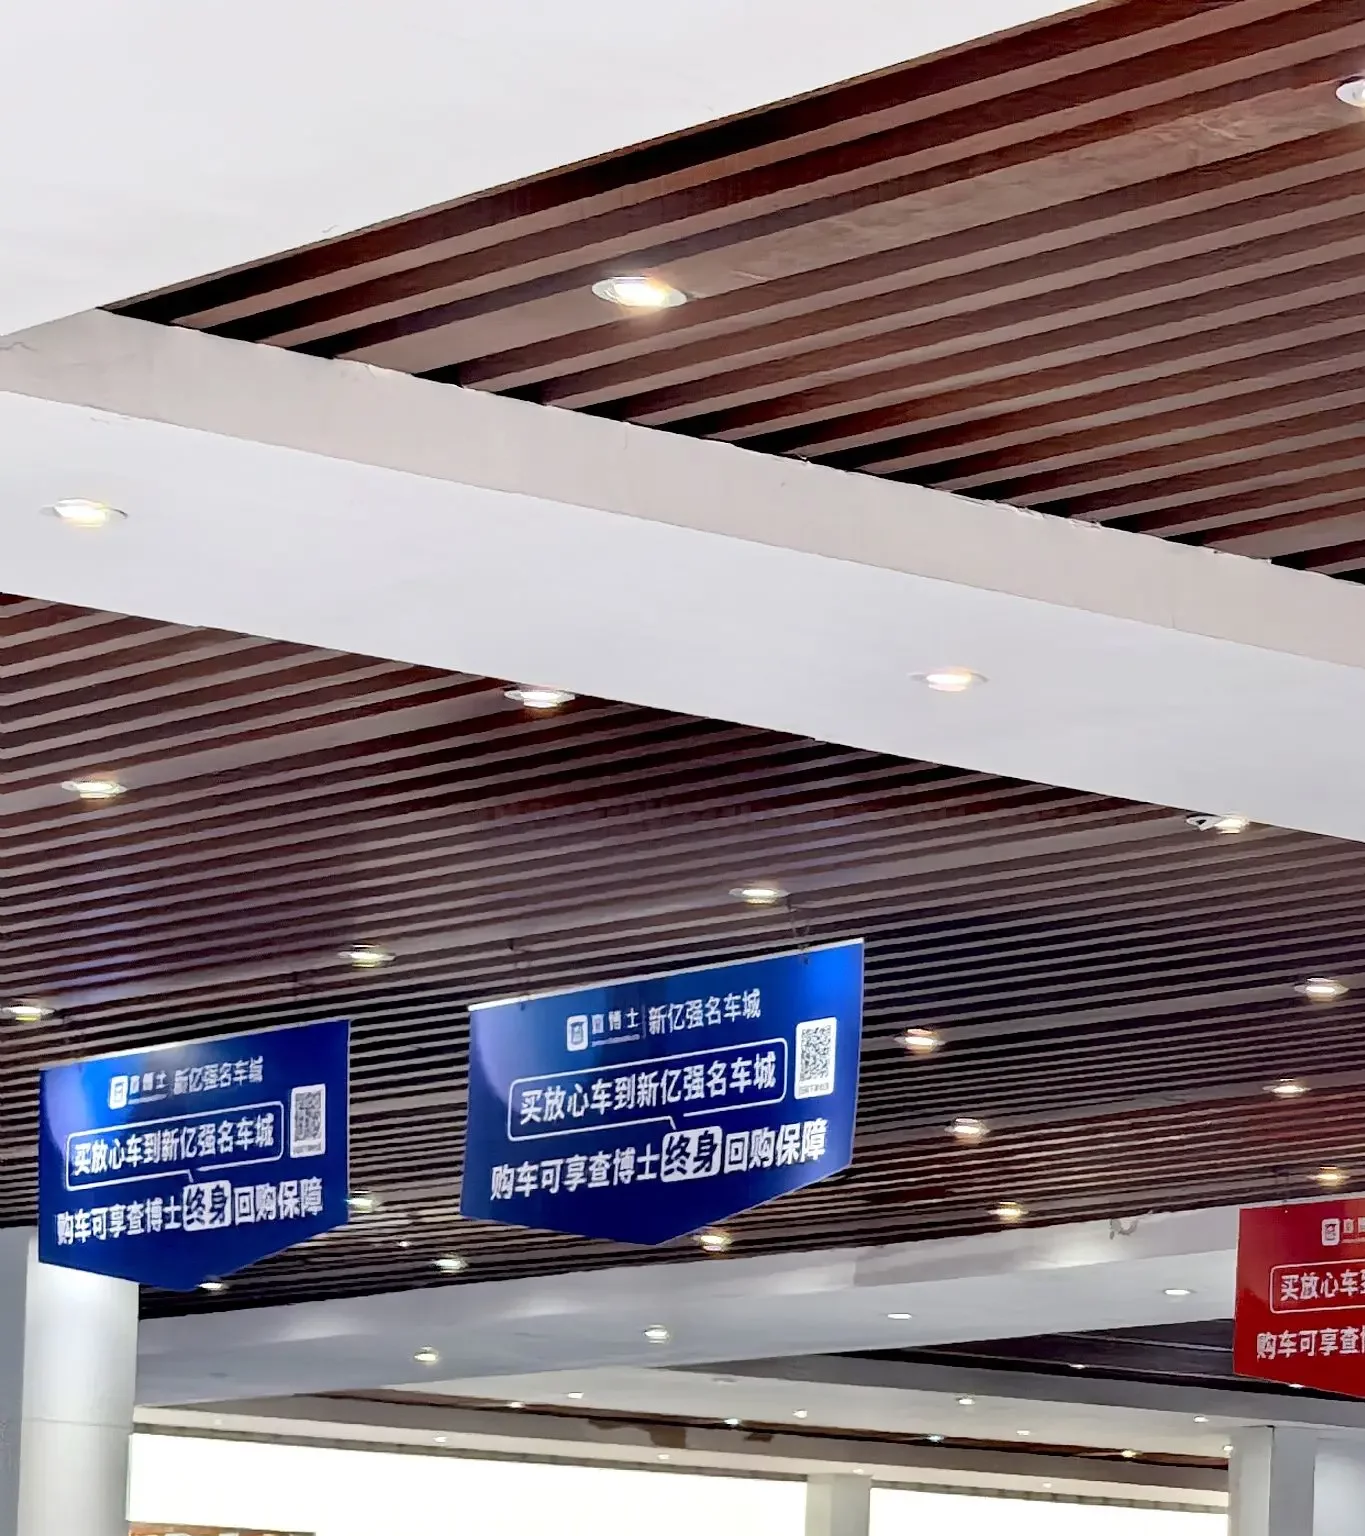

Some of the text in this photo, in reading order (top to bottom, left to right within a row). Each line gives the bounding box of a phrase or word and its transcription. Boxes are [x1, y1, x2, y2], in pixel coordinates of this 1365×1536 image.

[648, 989, 761, 1036] 新亿强名车城
[520, 1052, 777, 1125] 买放心车到新亿强名车城
[72, 1113, 274, 1176] 买放心车到新亿强名车城
[491, 1117, 830, 1201] 购车可享查博士终身回购保障
[56, 1176, 324, 1246] 购车可享查博士终身回购保障
